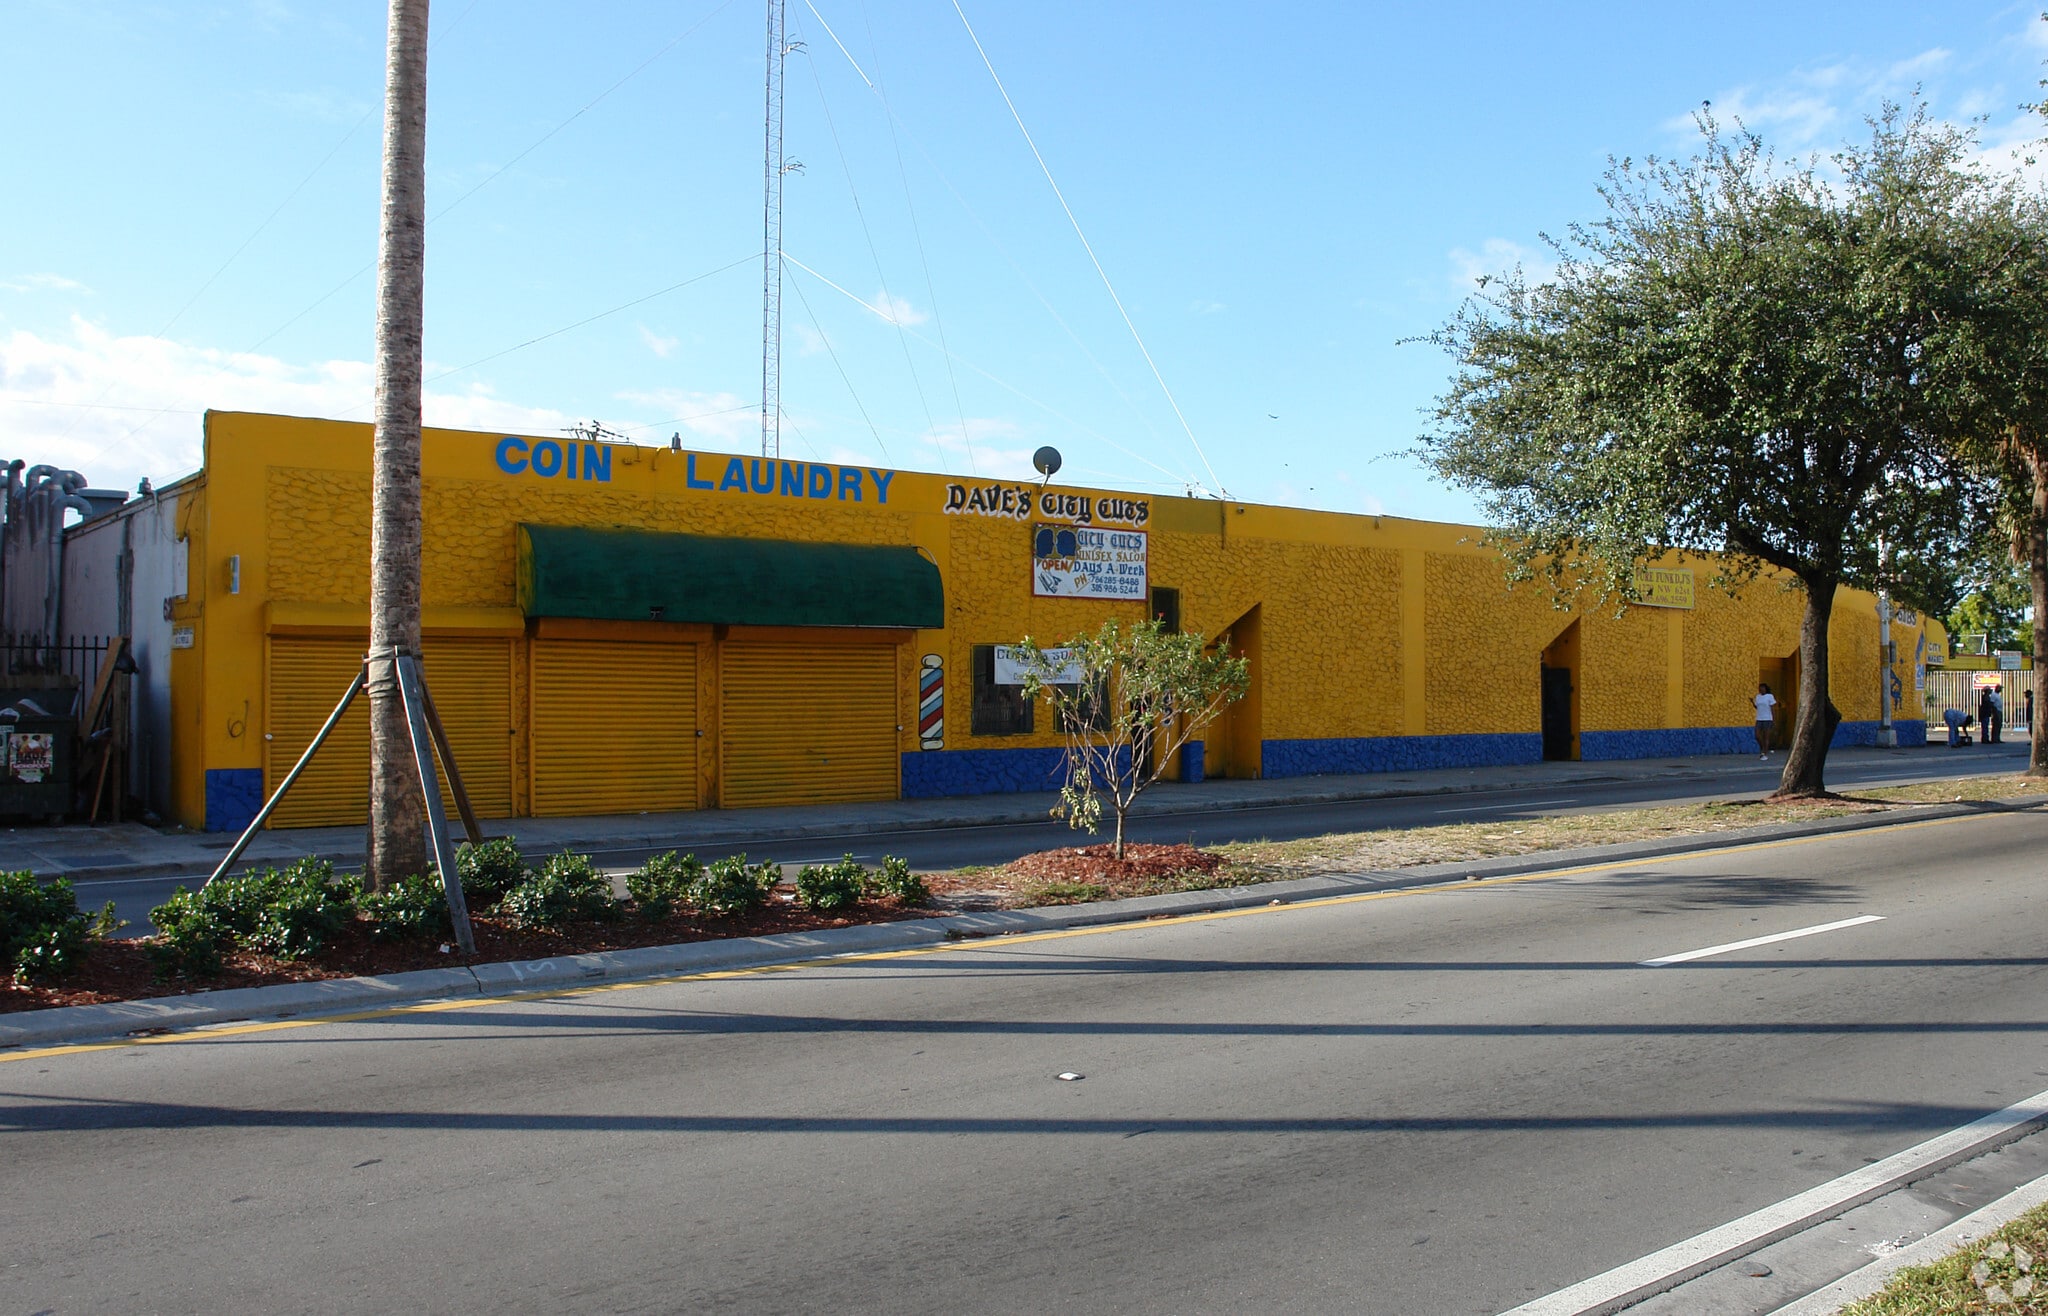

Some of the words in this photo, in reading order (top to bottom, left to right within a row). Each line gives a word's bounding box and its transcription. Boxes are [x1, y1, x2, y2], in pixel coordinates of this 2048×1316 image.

[495, 437, 611, 482] COIN
[687, 454, 894, 504] LAUNDRY
[944, 484, 1032, 521] DAVE'S
[1040, 493, 1092, 525] CITY
[1097, 498, 1150, 526] CUTS
[1078, 530, 1104, 548] CITY
[1111, 533, 1143, 549] CUTS
[1117, 551, 1145, 562] SALON
[1042, 560, 1068, 571] OPEN
[1106, 563, 1115, 574] A
[1074, 573, 1087, 588] PH
[1657, 584, 1671, 593] NW
[1928, 643, 1942, 652] CITY
